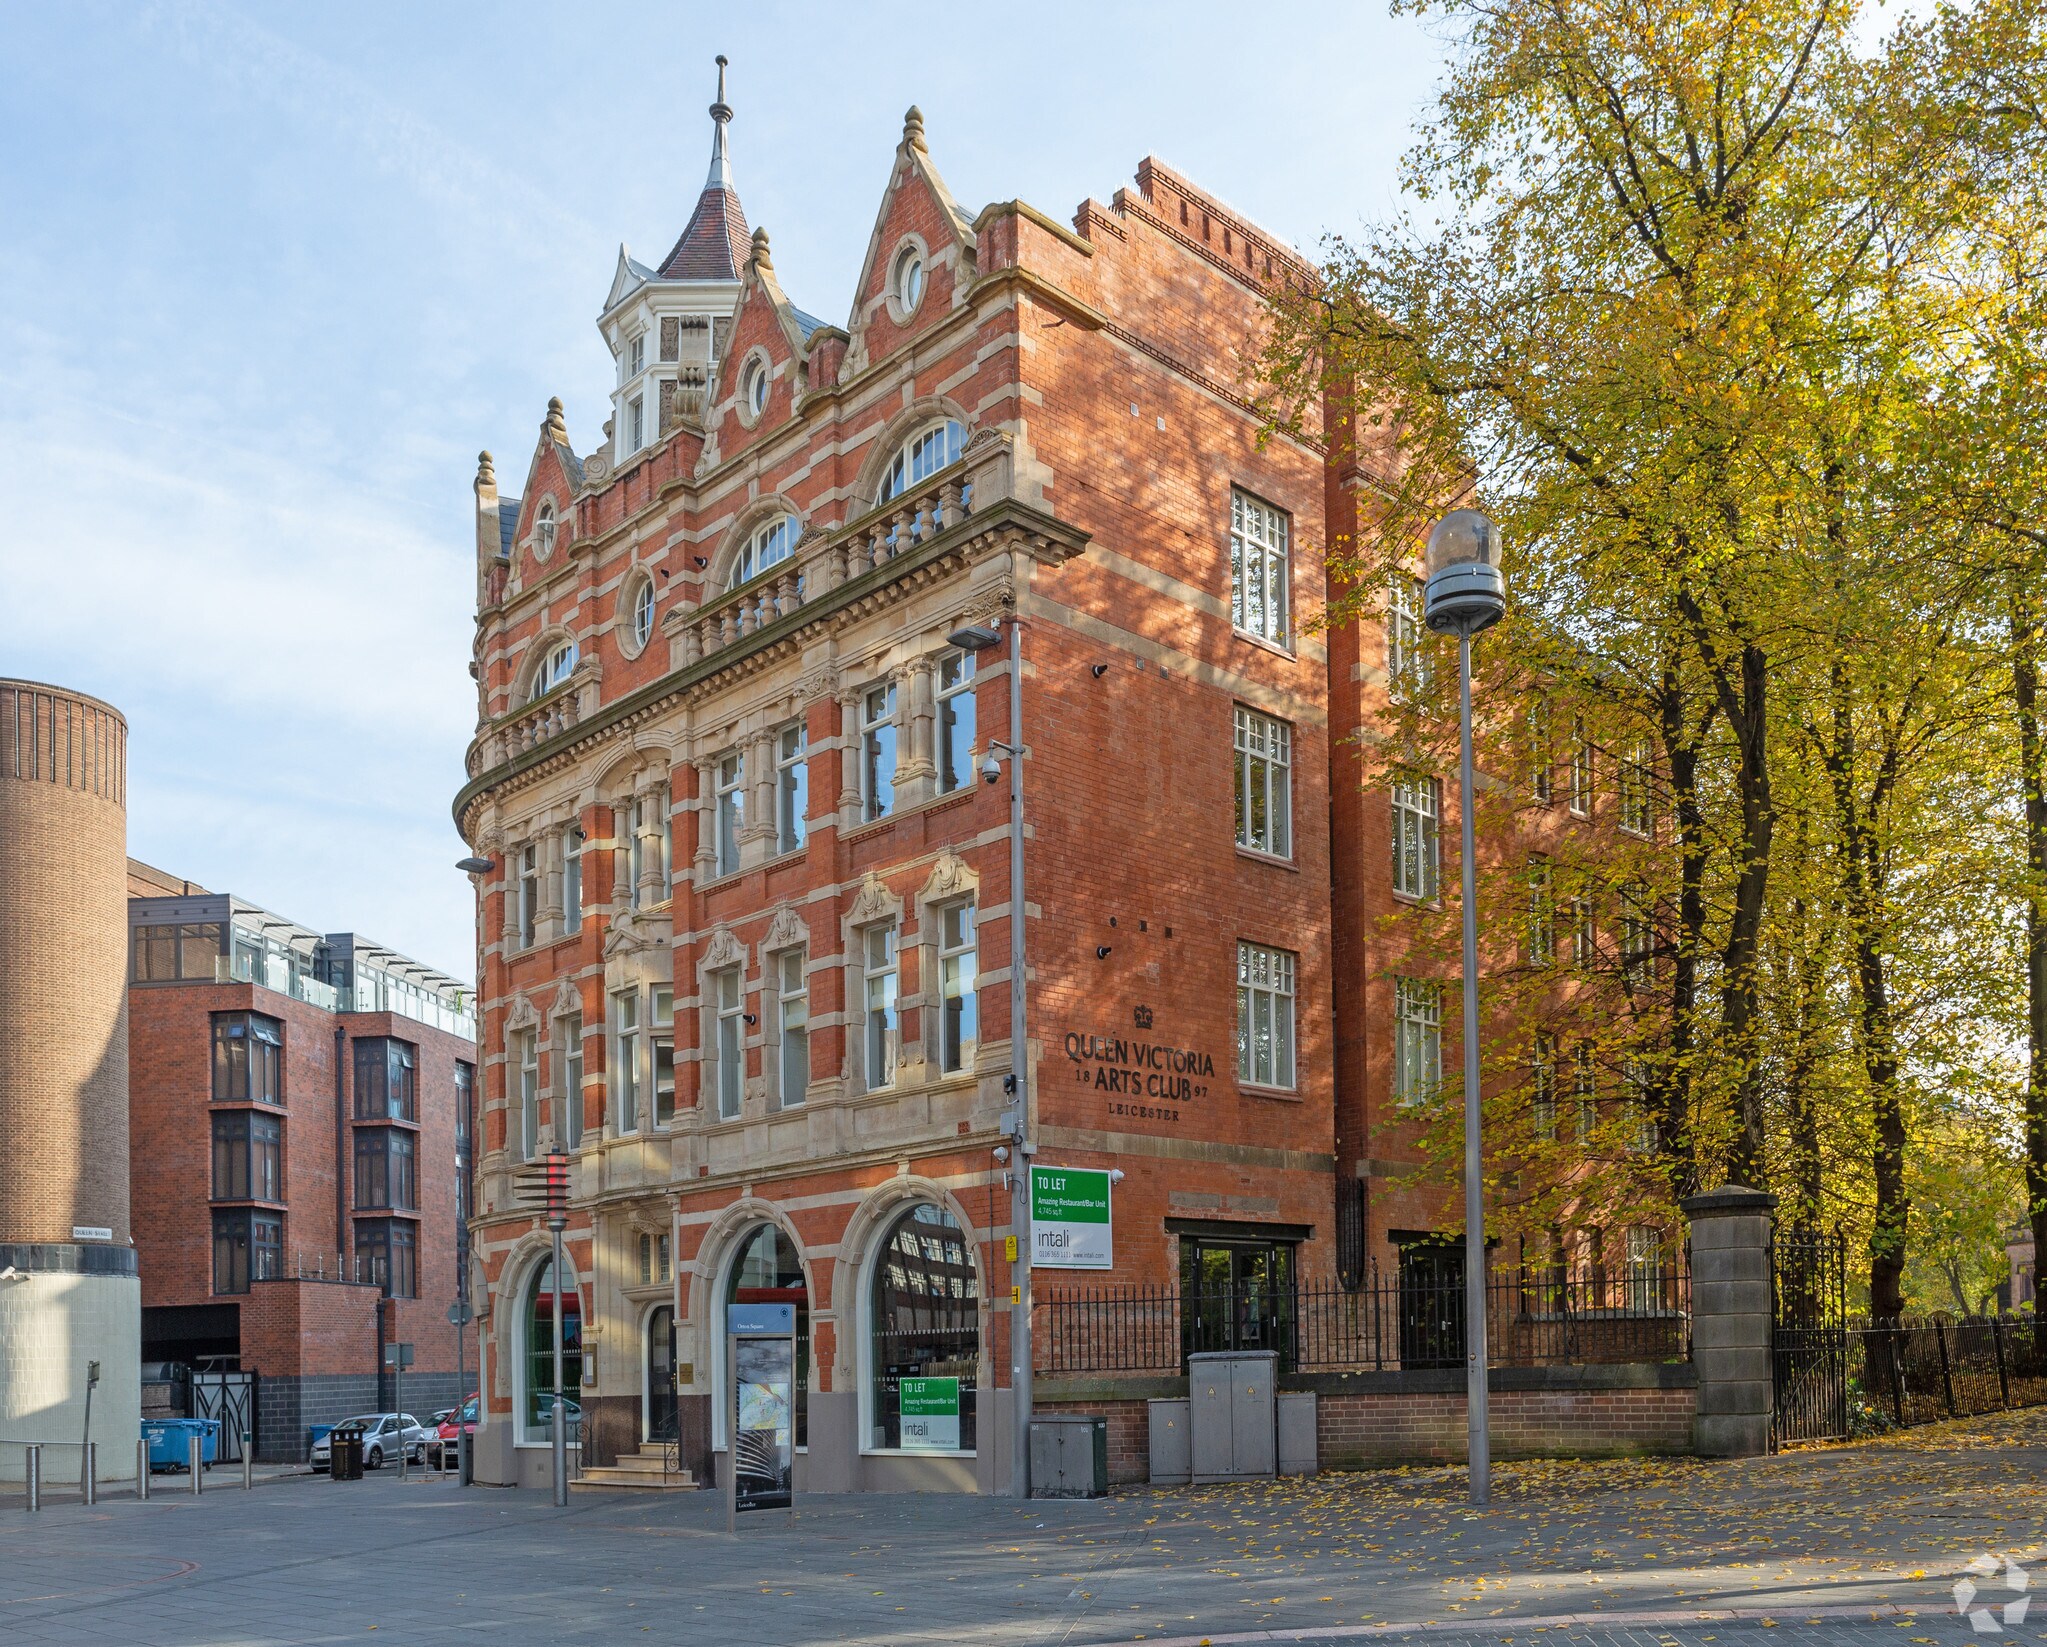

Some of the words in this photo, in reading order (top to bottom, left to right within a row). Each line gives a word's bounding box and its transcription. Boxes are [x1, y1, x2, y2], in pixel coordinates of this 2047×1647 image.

[1065, 1032, 1128, 1064] QUEEN
[1132, 1042, 1215, 1077] VICTORIA
[1075, 1069, 1090, 1083] 18
[1094, 1066, 1142, 1095] ARTS
[1147, 1073, 1191, 1101] CLUB
[1194, 1085, 1208, 1098] 97
[1108, 1102, 1179, 1121] LEICESTER
[1037, 1176, 1049, 1190] TO
[1051, 1178, 1066, 1190] LET
[1037, 1197, 1058, 1207] Amazing
[1059, 1198, 1095, 1207] Restaurant/Bar
[1095, 1200, 1106, 1208] Unit
[1038, 1228, 1069, 1248] intali
[904, 1382, 912, 1392] TO
[914, 1382, 926, 1392] LET
[904, 1421, 928, 1436] intali
